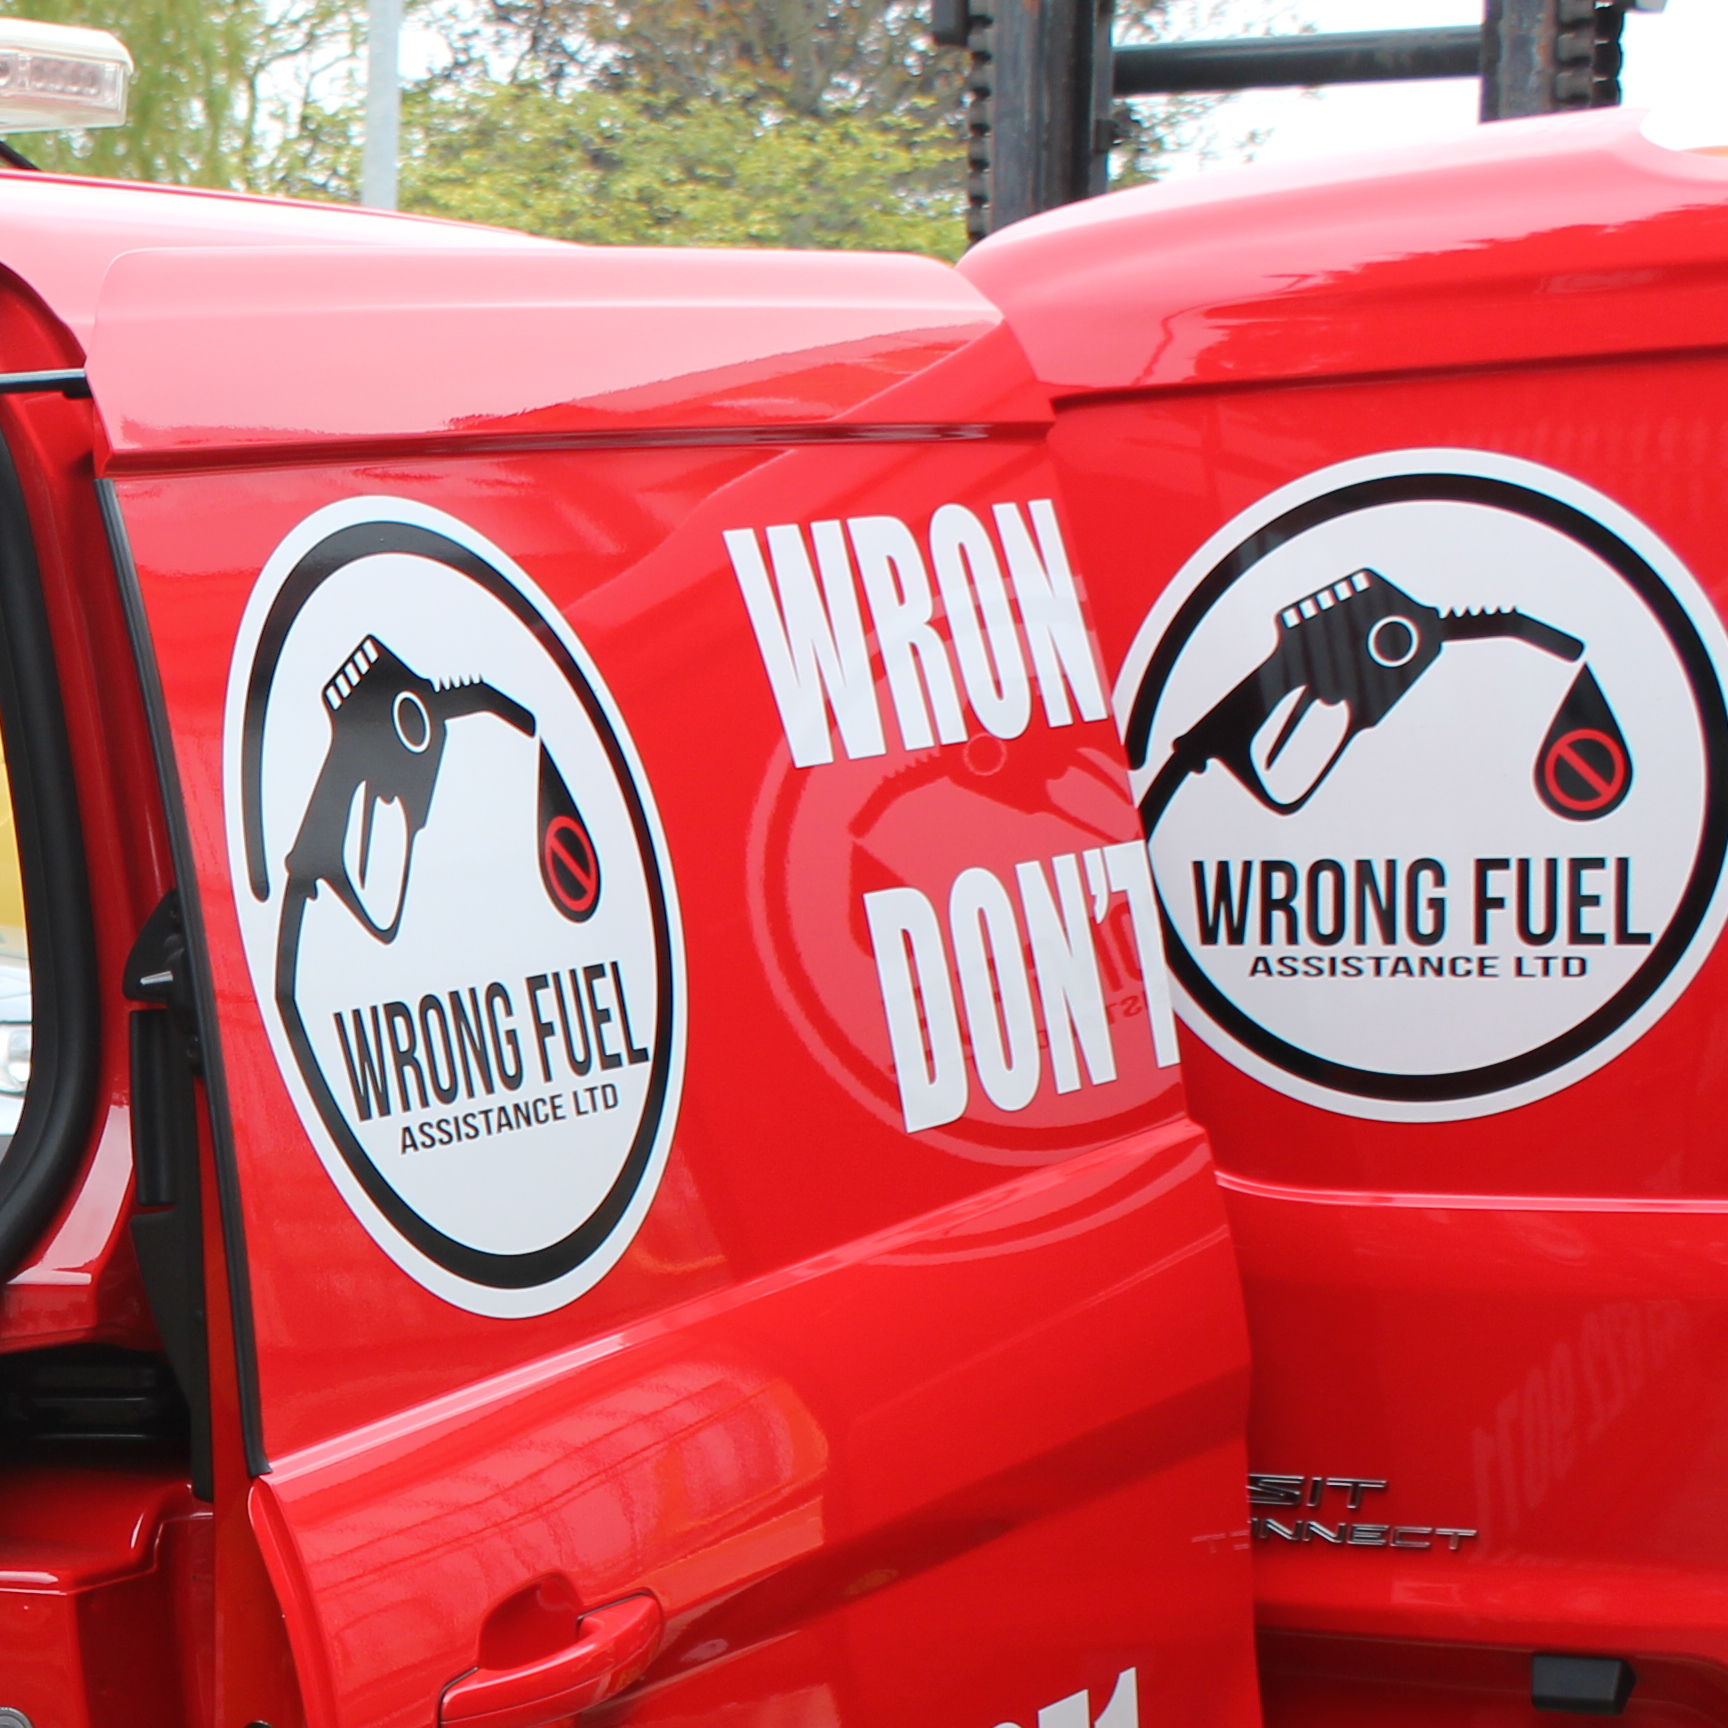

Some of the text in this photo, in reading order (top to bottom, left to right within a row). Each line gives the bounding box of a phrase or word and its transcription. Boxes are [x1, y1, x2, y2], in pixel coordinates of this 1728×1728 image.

[1192, 857, 1652, 947] WRONG FUEL
[863, 840, 1181, 1133] DON'T
[1249, 956, 1587, 978] ASSISTANCE LTD
[333, 961, 650, 1122] WRONG FUEL
[400, 1083, 619, 1155] ASSISTANCE LTD
[1247, 1517, 1477, 1550] NNECT
